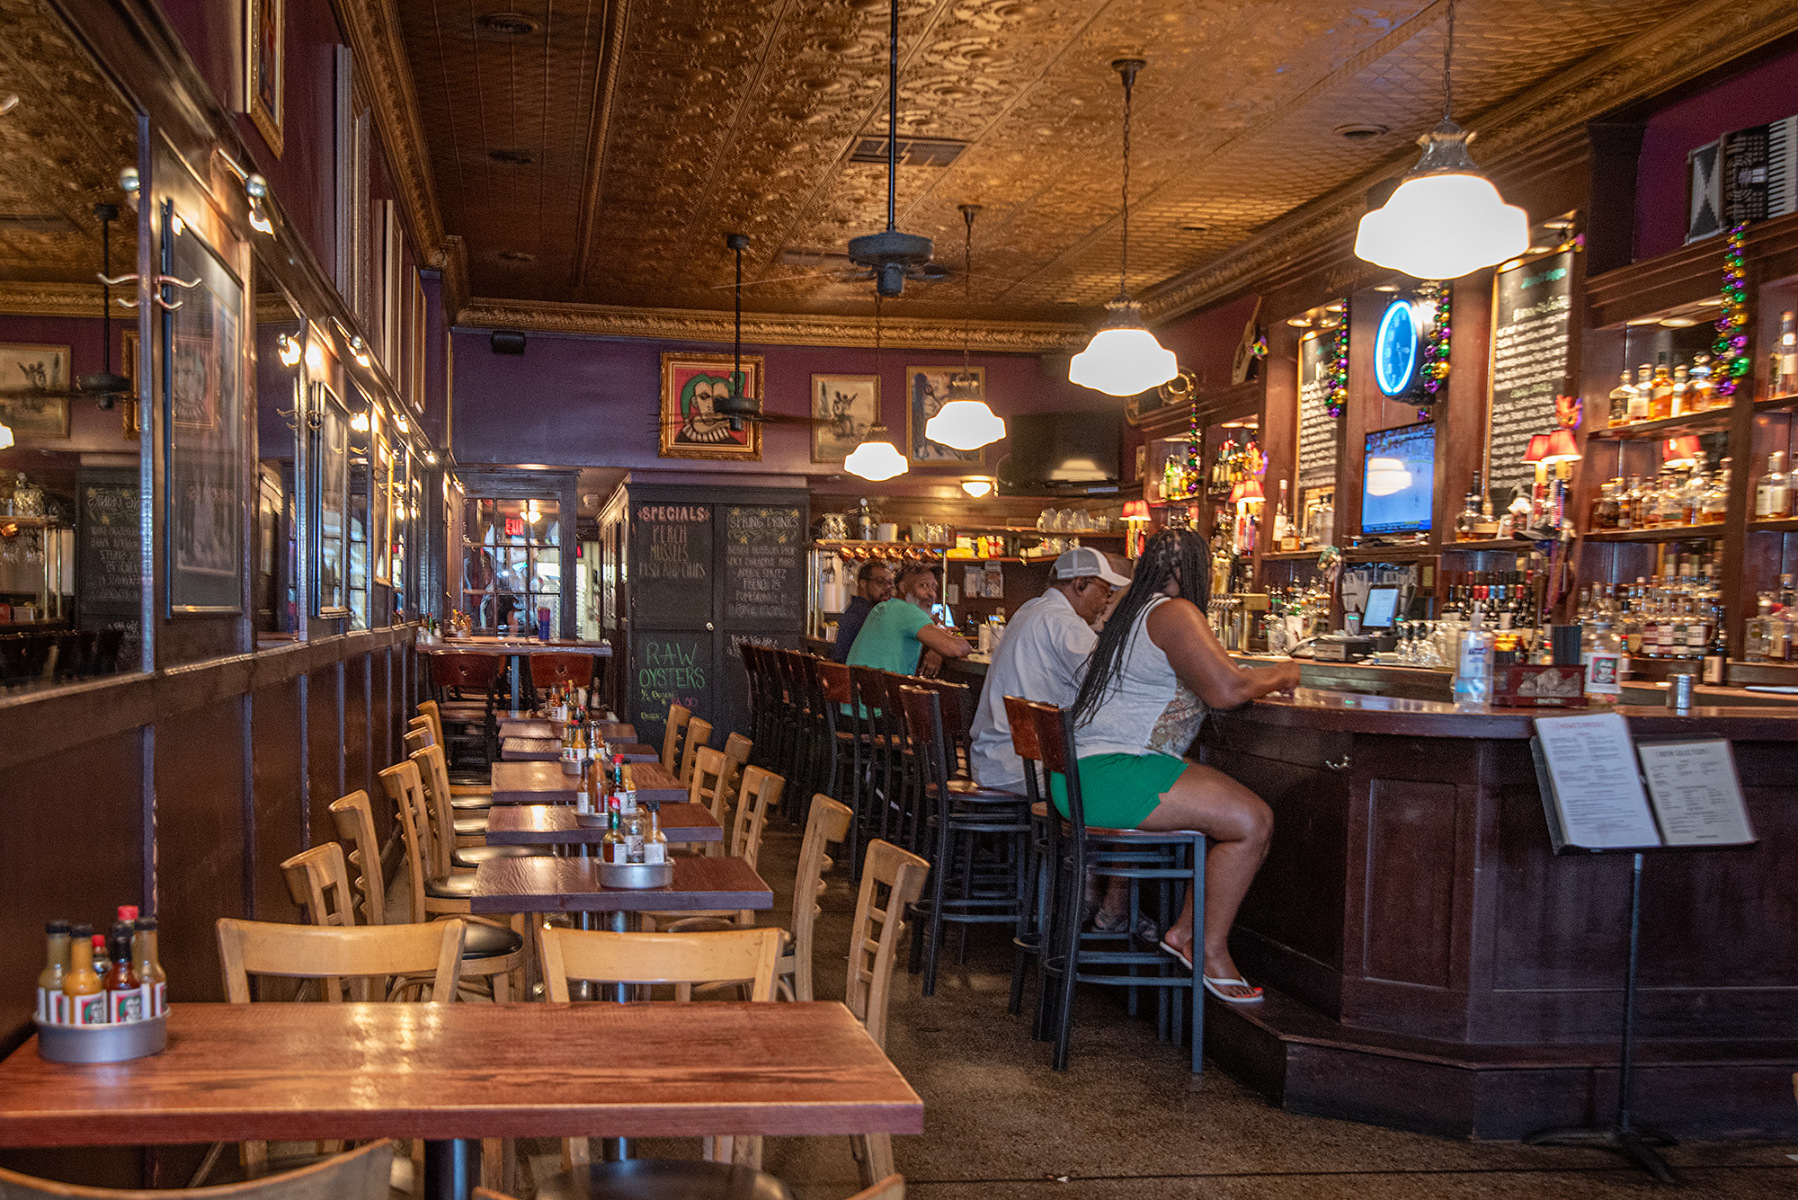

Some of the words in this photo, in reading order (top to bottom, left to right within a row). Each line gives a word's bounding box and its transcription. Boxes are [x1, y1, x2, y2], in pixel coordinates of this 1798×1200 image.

[642, 506, 705, 522] SPECIALS
[729, 515, 764, 529] SPRING
[767, 516, 799, 529] DRINKS
[652, 524, 688, 543] PERCH
[646, 641, 697, 666] RAW
[639, 666, 706, 689] OYSTERS
